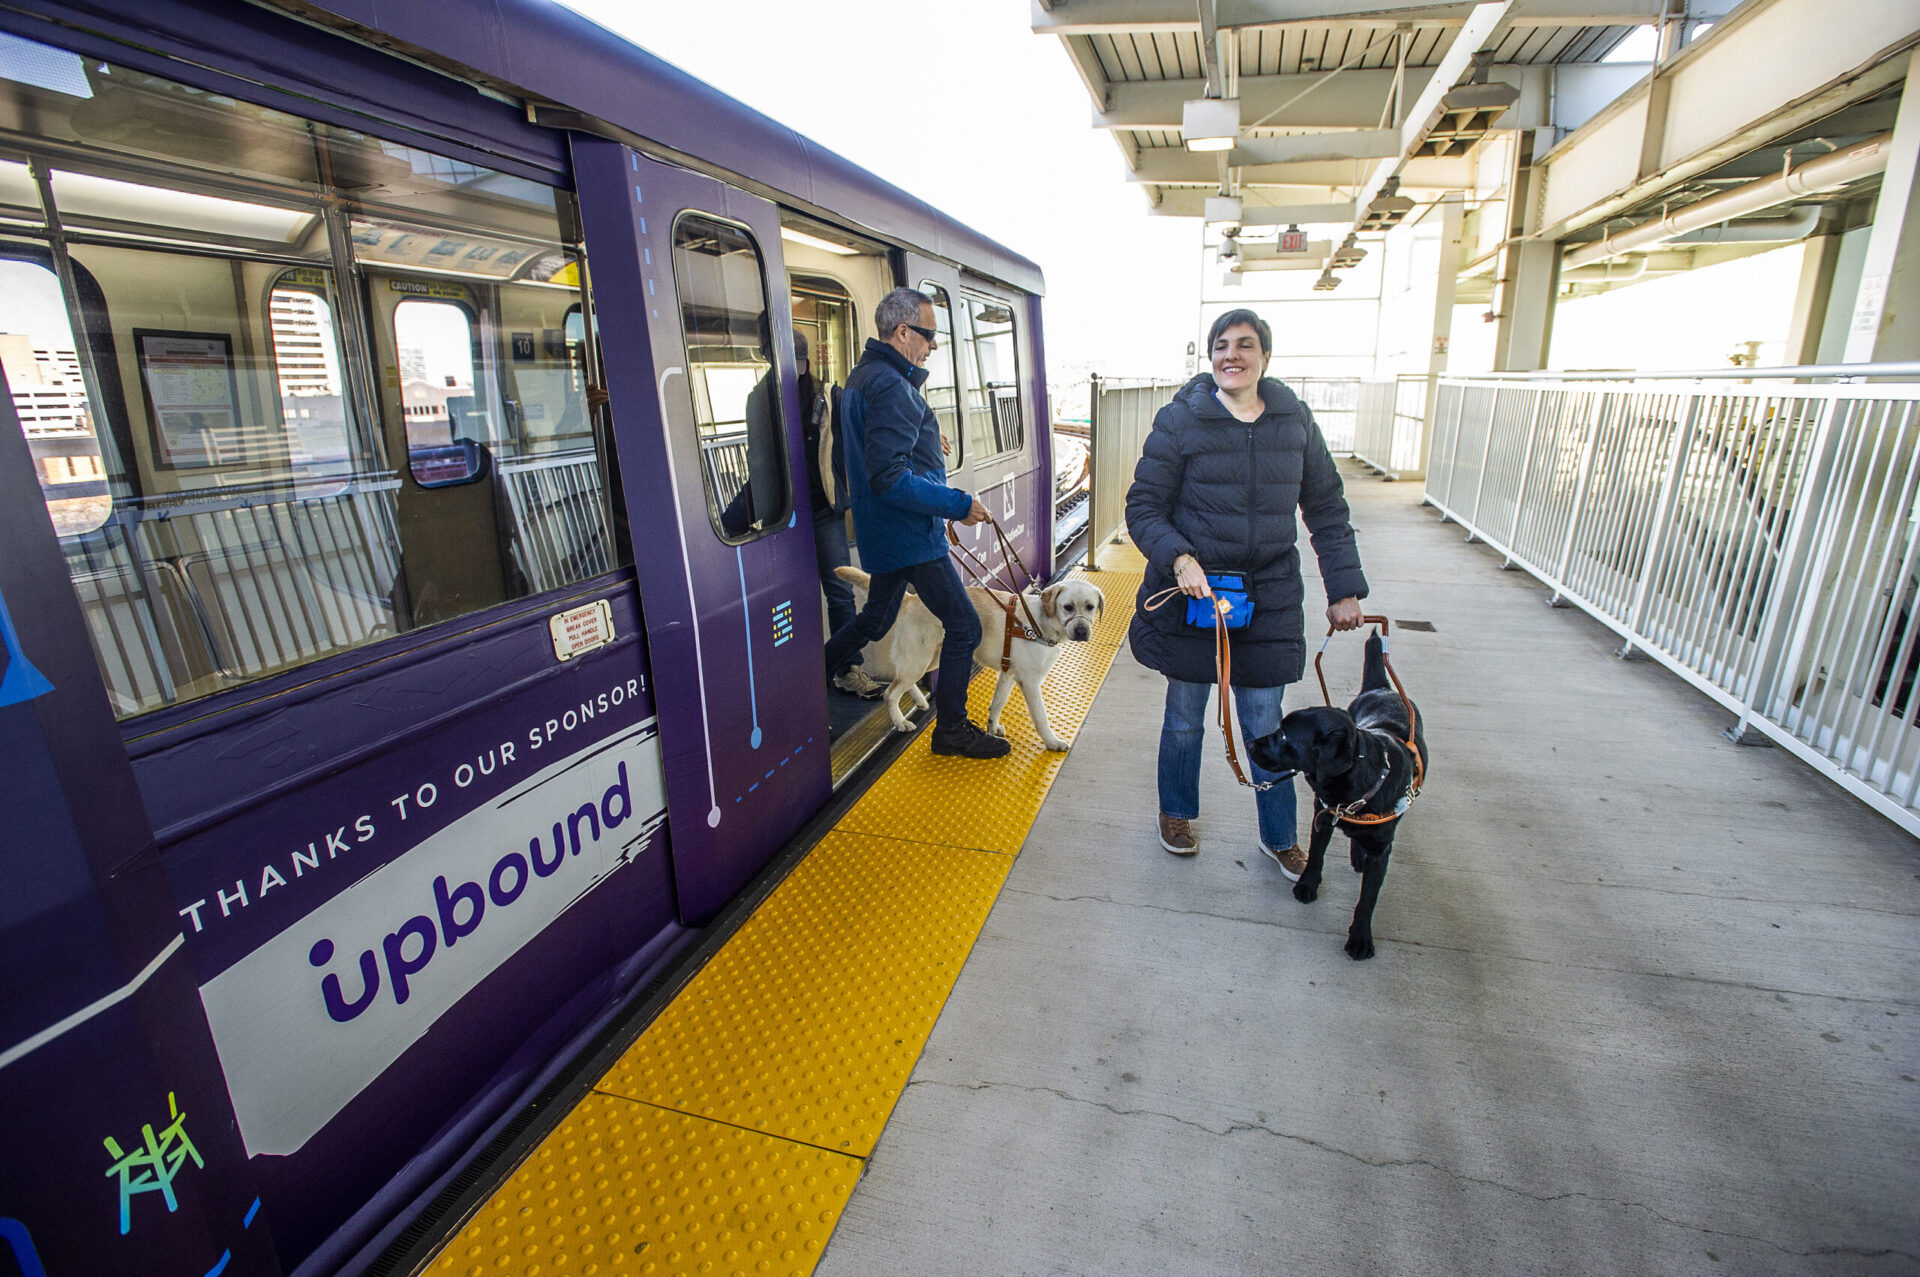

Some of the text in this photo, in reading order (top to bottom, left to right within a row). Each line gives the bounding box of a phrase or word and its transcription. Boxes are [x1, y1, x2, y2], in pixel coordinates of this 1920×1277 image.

[1283, 234, 1303, 249] EXIT
[391, 281, 427, 293] CAUTION
[517, 340, 530, 354] 10
[570, 609, 596, 622] EMERGENCY
[566, 617, 597, 632] BREAK COVER
[569, 626, 598, 641] PULL HANDLE
[572, 635, 599, 649] OPEN DOORS
[179, 675, 647, 932] THANKS TO OUR SPONSOR!
[309, 761, 633, 1022] upbound
